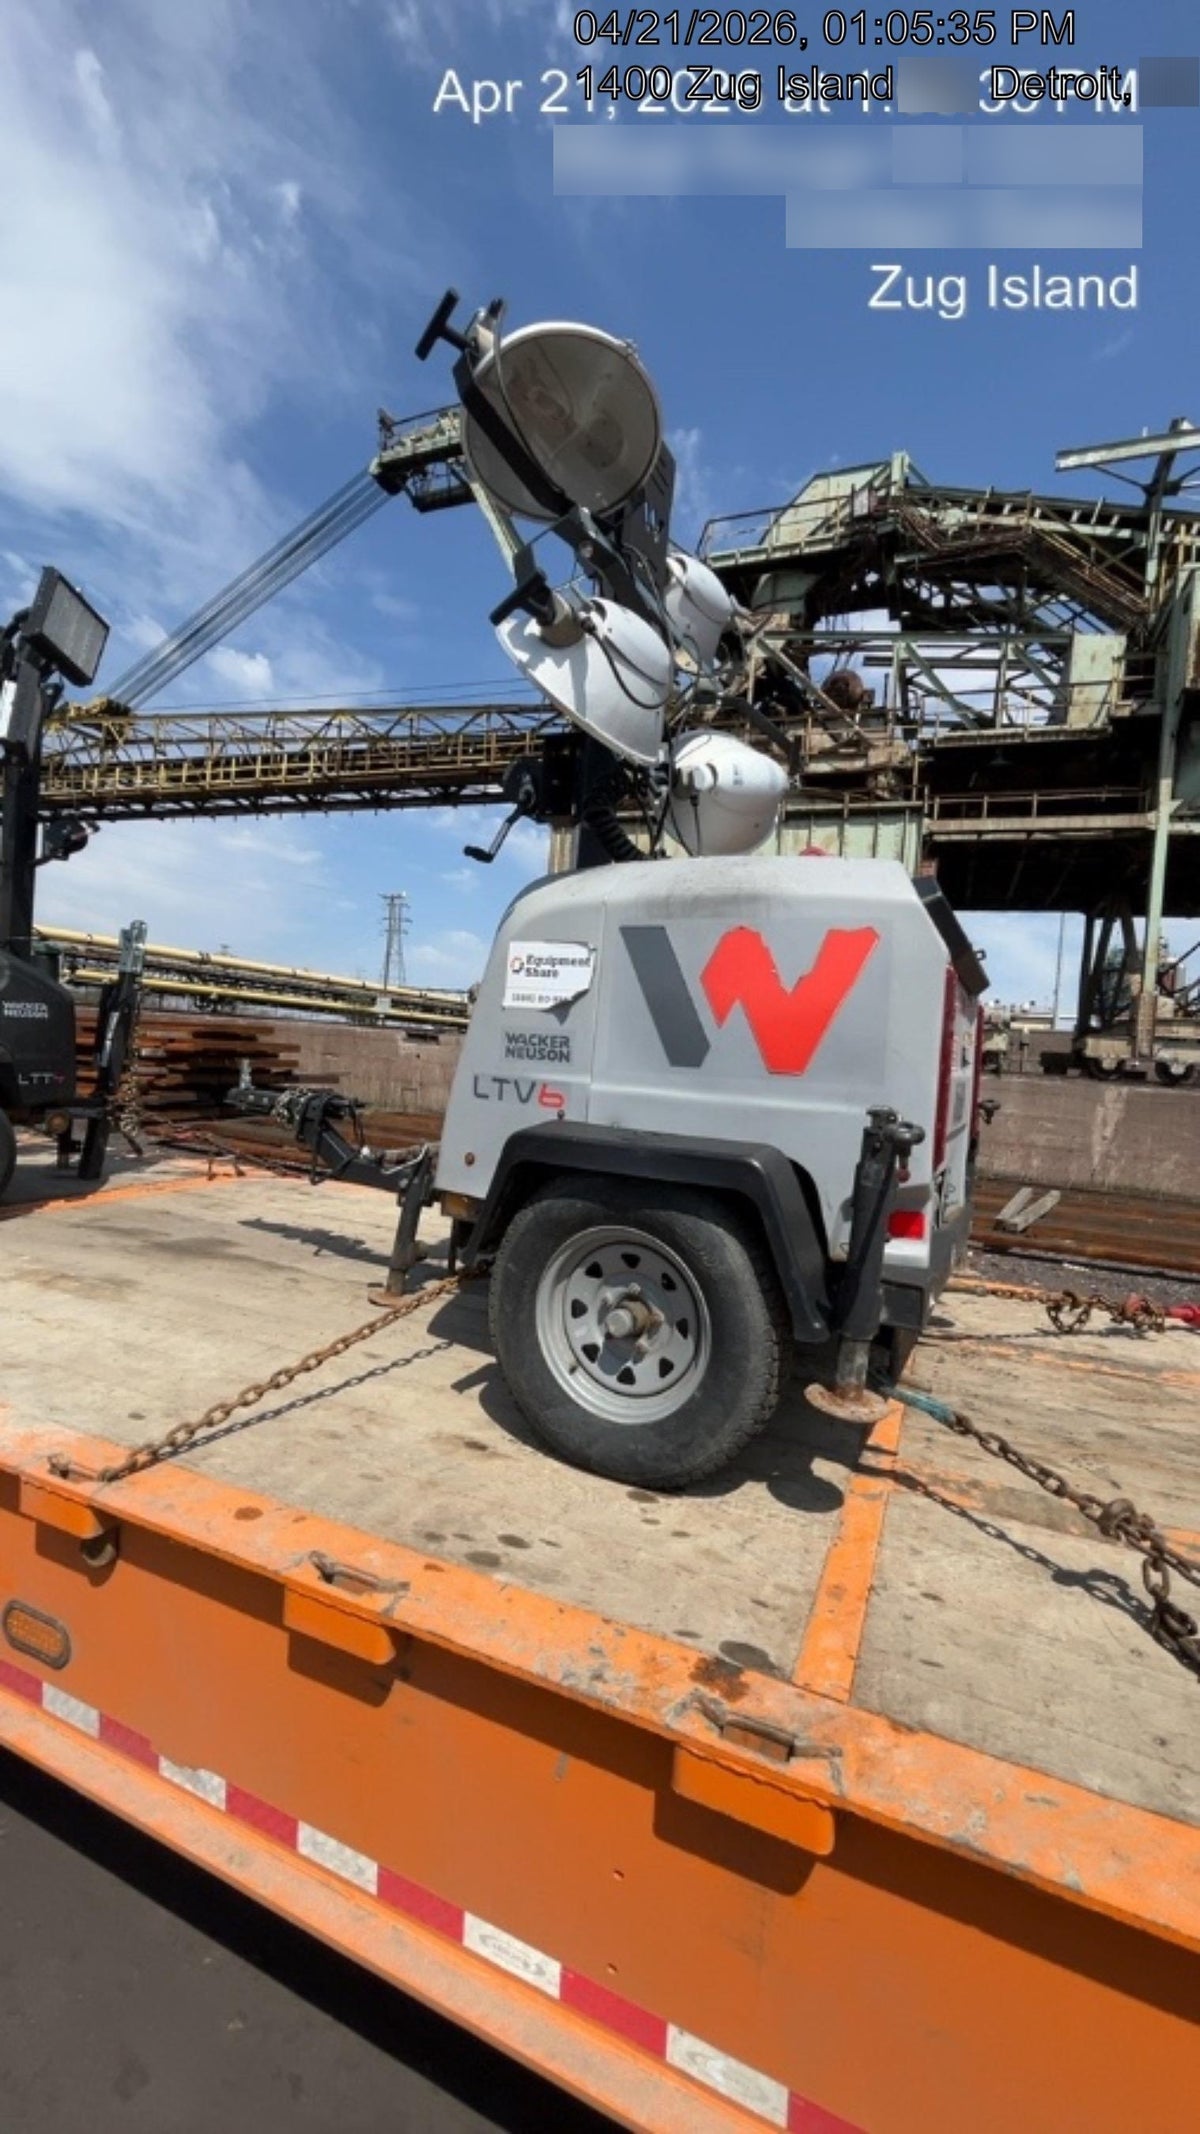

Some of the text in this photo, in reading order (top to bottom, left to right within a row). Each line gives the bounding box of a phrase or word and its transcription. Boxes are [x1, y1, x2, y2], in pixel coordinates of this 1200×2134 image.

[525, 954, 591, 968] Equipment
[525, 966, 559, 978] Share
[505, 1032, 570, 1049] WACKER
[505, 1046, 570, 1063] NEUSON
[473, 1074, 566, 1109] LTV6
